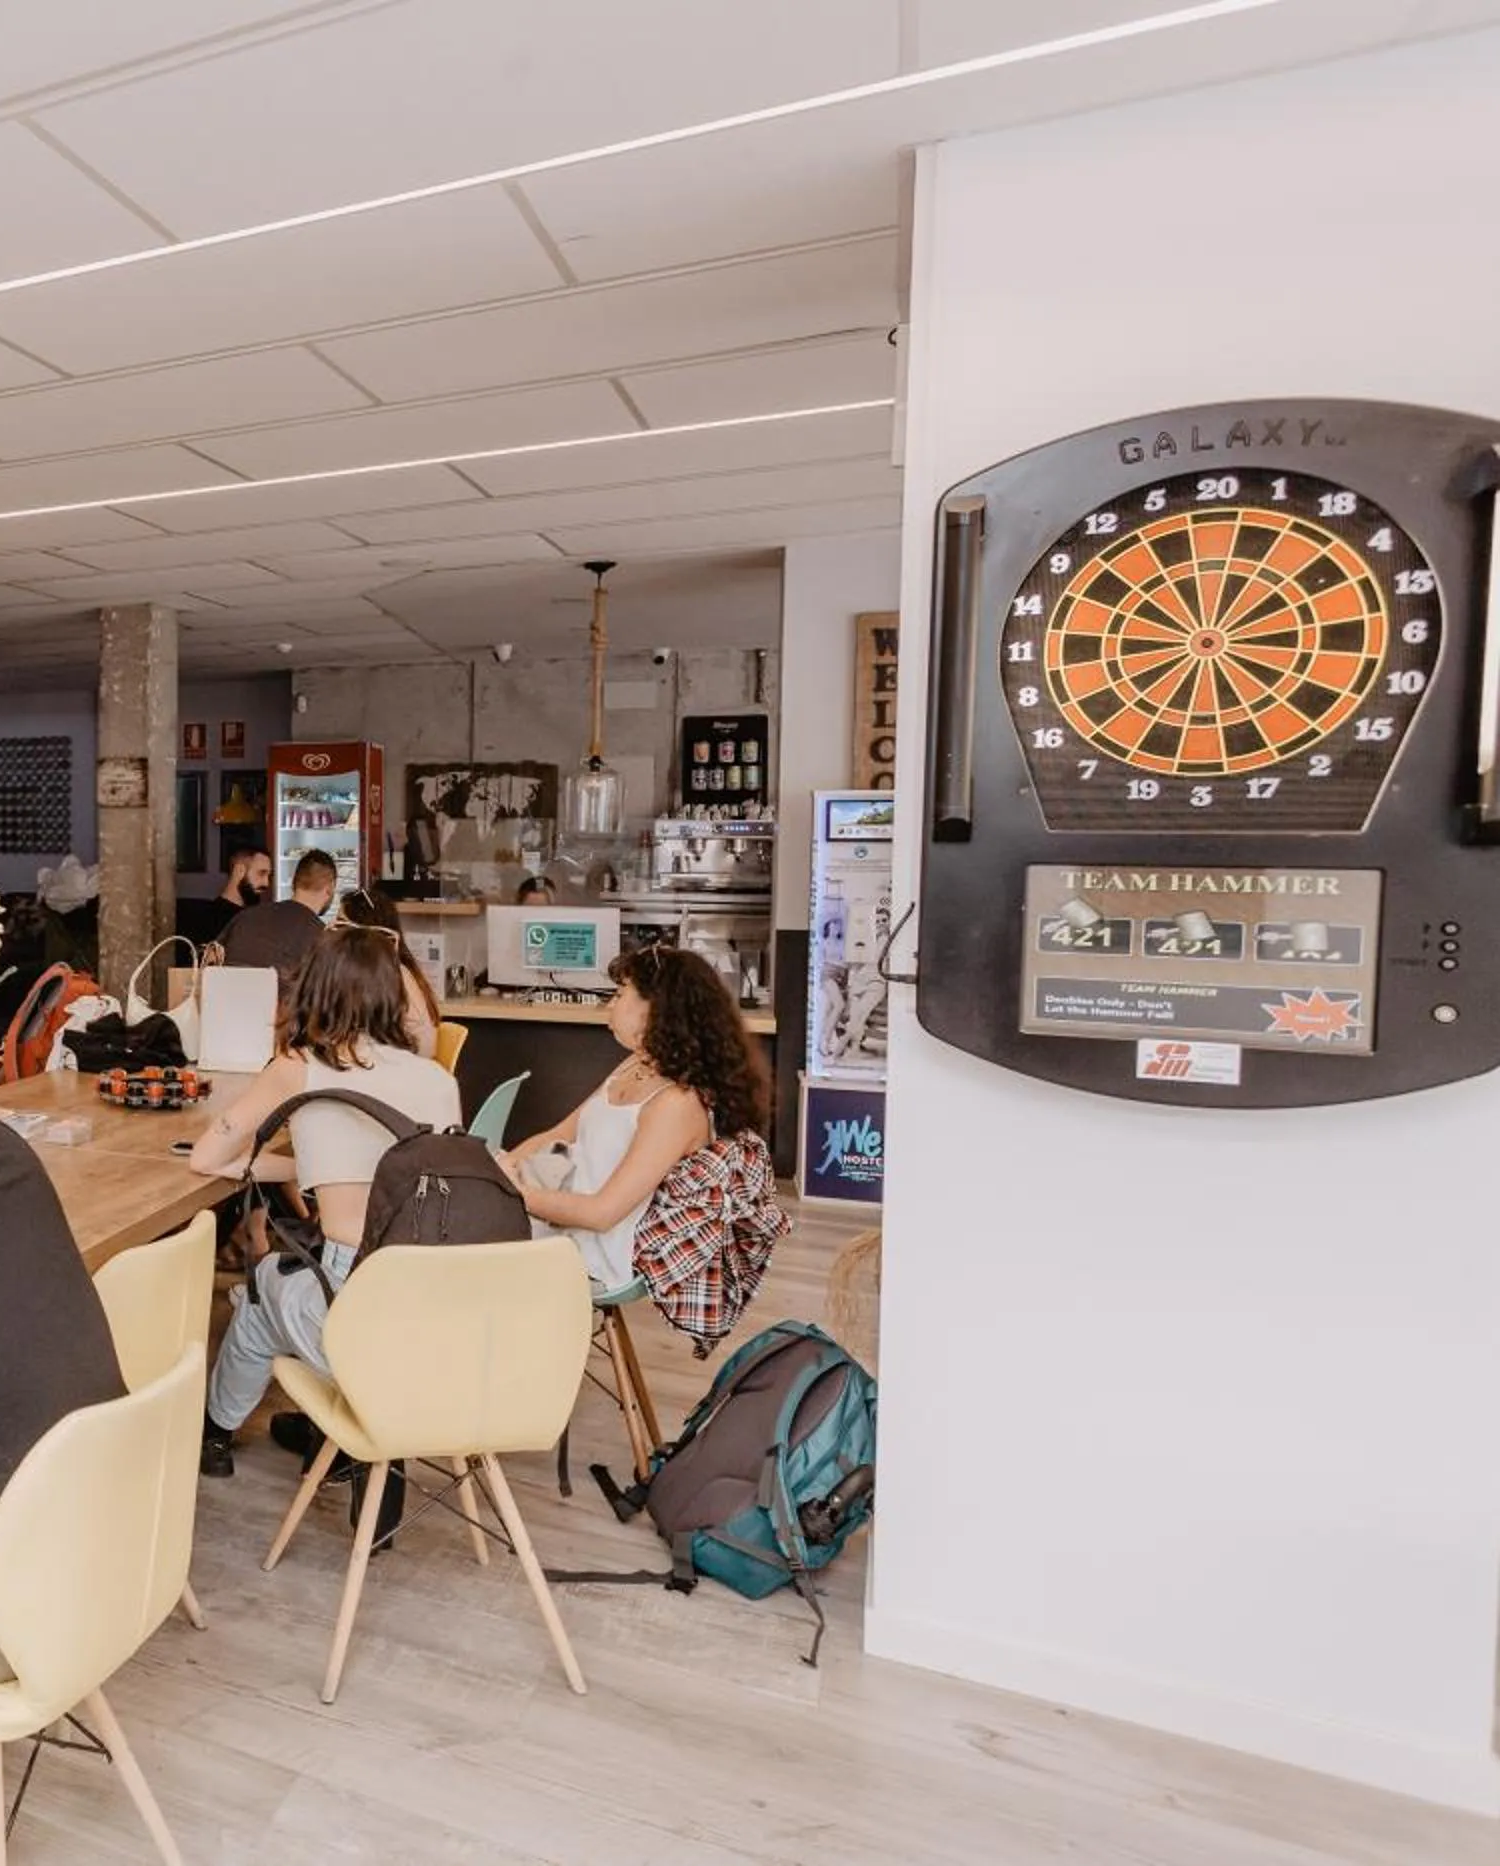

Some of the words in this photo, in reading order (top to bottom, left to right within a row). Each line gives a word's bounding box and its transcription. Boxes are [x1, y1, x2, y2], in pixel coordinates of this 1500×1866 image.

[1118, 416, 1323, 465] GALAXY
[1143, 487, 1167, 511] 5
[1195, 476, 1240, 501] 20
[1270, 477, 1288, 501] 1
[1317, 491, 1358, 517] 18
[1084, 512, 1120, 535] 12
[1366, 527, 1394, 552] 4
[1050, 553, 1071, 574] 9
[1394, 569, 1436, 595] 13
[1013, 594, 1043, 616] 14
[1402, 619, 1429, 644] 6
[1008, 640, 1034, 662] 11
[1386, 670, 1426, 695] 10
[1018, 686, 1040, 707] 8
[1031, 727, 1065, 748] 16
[1355, 717, 1394, 741] 15
[1077, 759, 1100, 780] 7
[1308, 754, 1332, 777] 2
[1126, 779, 1161, 800] 19
[1189, 785, 1214, 807] 3
[1245, 777, 1282, 799] 17
[1061, 871, 1159, 891] TEAM
[1170, 873, 1342, 896] HAMMER
[1051, 925, 1112, 947] 421
[1119, 983, 1155, 995] TEAM
